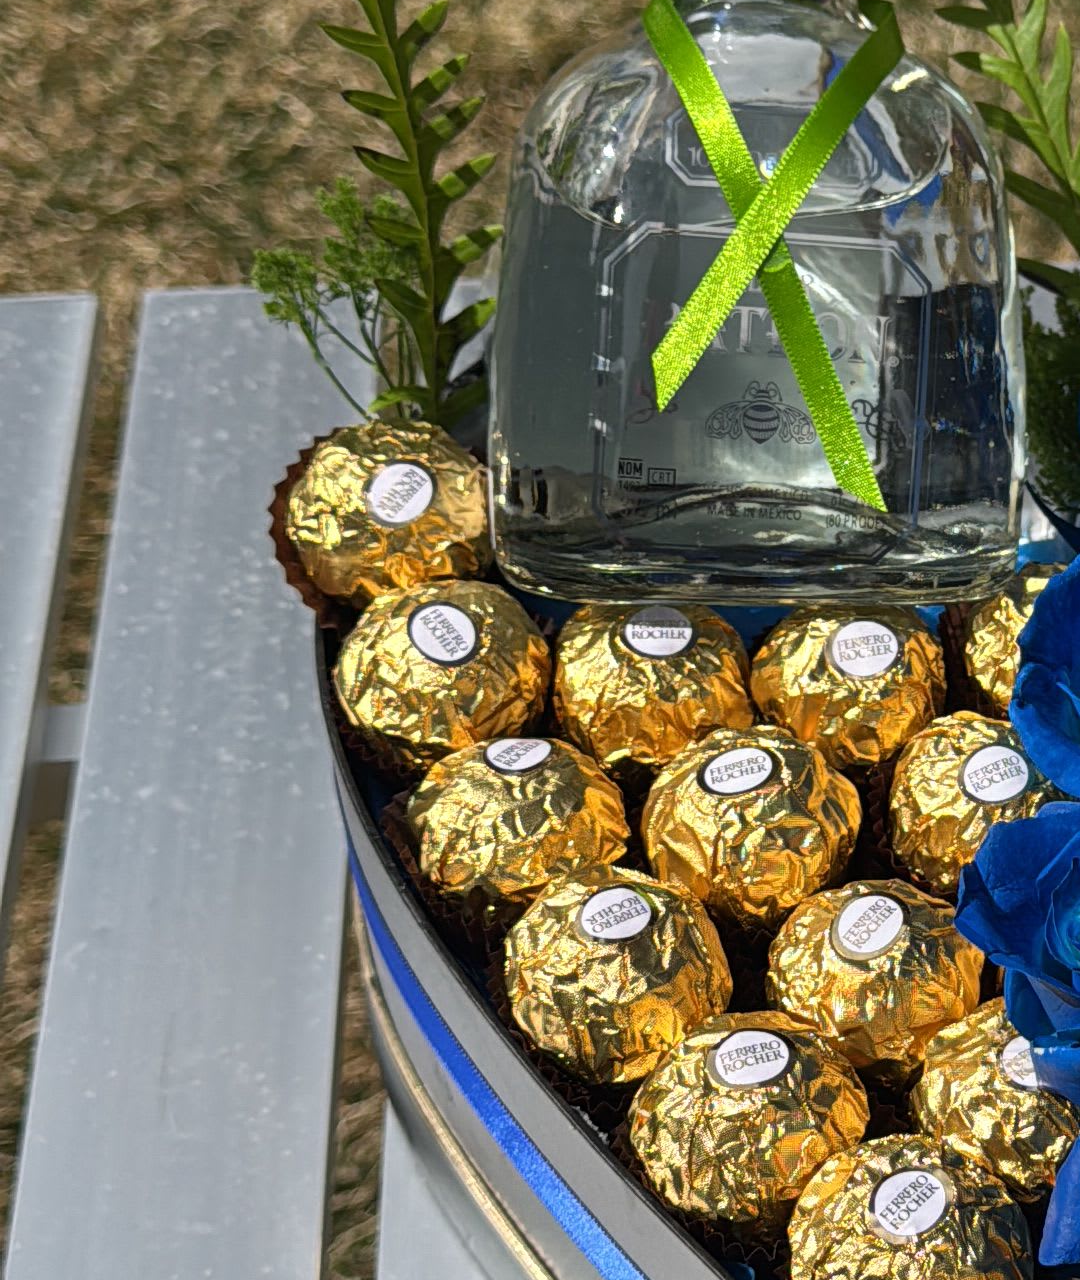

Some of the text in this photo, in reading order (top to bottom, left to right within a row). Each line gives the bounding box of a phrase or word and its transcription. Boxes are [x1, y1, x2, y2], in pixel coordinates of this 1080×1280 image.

[617, 461, 643, 477] NOM
[420, 614, 459, 657] ROCHER
[430, 608, 468, 652] FERRERO
[631, 629, 687, 640] ROCHER
[837, 633, 892, 652] FERRERO
[709, 755, 767, 777] FERRERO
[711, 764, 767, 784] ROCHER
[967, 755, 1020, 783] FERRERO
[972, 765, 1026, 793] ROCHER
[584, 895, 642, 925] ROCHER
[592, 904, 648, 933] FERRERO
[842, 898, 887, 943] FERRERO
[852, 905, 897, 949] ROCHER
[719, 1040, 781, 1065] FERRERO
[722, 1050, 785, 1076] ROCHER
[879, 1174, 929, 1220] FERRERO
